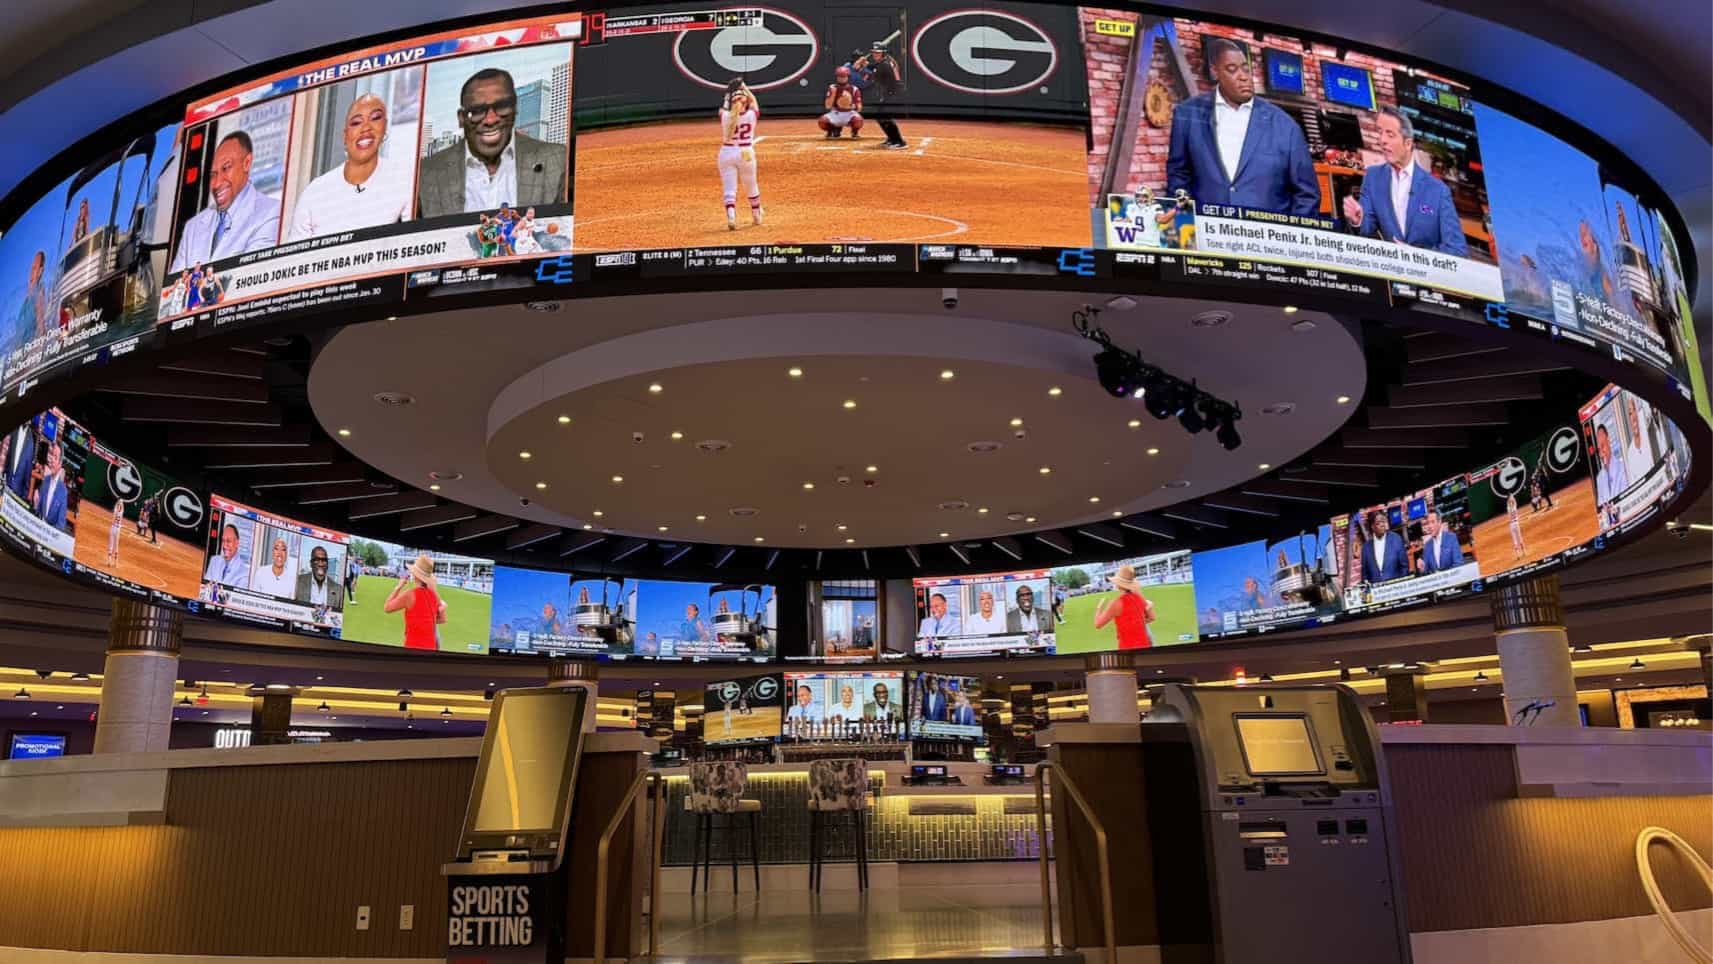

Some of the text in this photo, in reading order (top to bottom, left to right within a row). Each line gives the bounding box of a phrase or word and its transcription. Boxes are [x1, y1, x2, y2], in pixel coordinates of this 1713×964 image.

[1099, 22, 1132, 33] GET UP
[304, 47, 426, 85] THE REAL MVP
[1202, 204, 1220, 217] GET
[1223, 207, 1236, 217] UP
[1135, 216, 1145, 232] 9
[1115, 226, 1137, 243] W
[694, 248, 737, 257] Tennessee
[773, 245, 803, 255] Purdue
[831, 245, 843, 254] 72
[848, 246, 866, 254] Final
[1204, 221, 1458, 273] Is Michael Penix Jr. being overlooked in this draft?
[235, 240, 447, 291] SHOULD JOKIC BE THE NBA MVP THIS SEASON?
[736, 257, 748, 265] 40
[806, 255, 825, 264] Final
[825, 255, 842, 263] Four
[858, 255, 877, 263] since
[1317, 251, 1335, 263] both
[1380, 261, 1405, 276] college
[451, 885, 530, 916] SPORTS
[448, 916, 533, 946] BETTING
